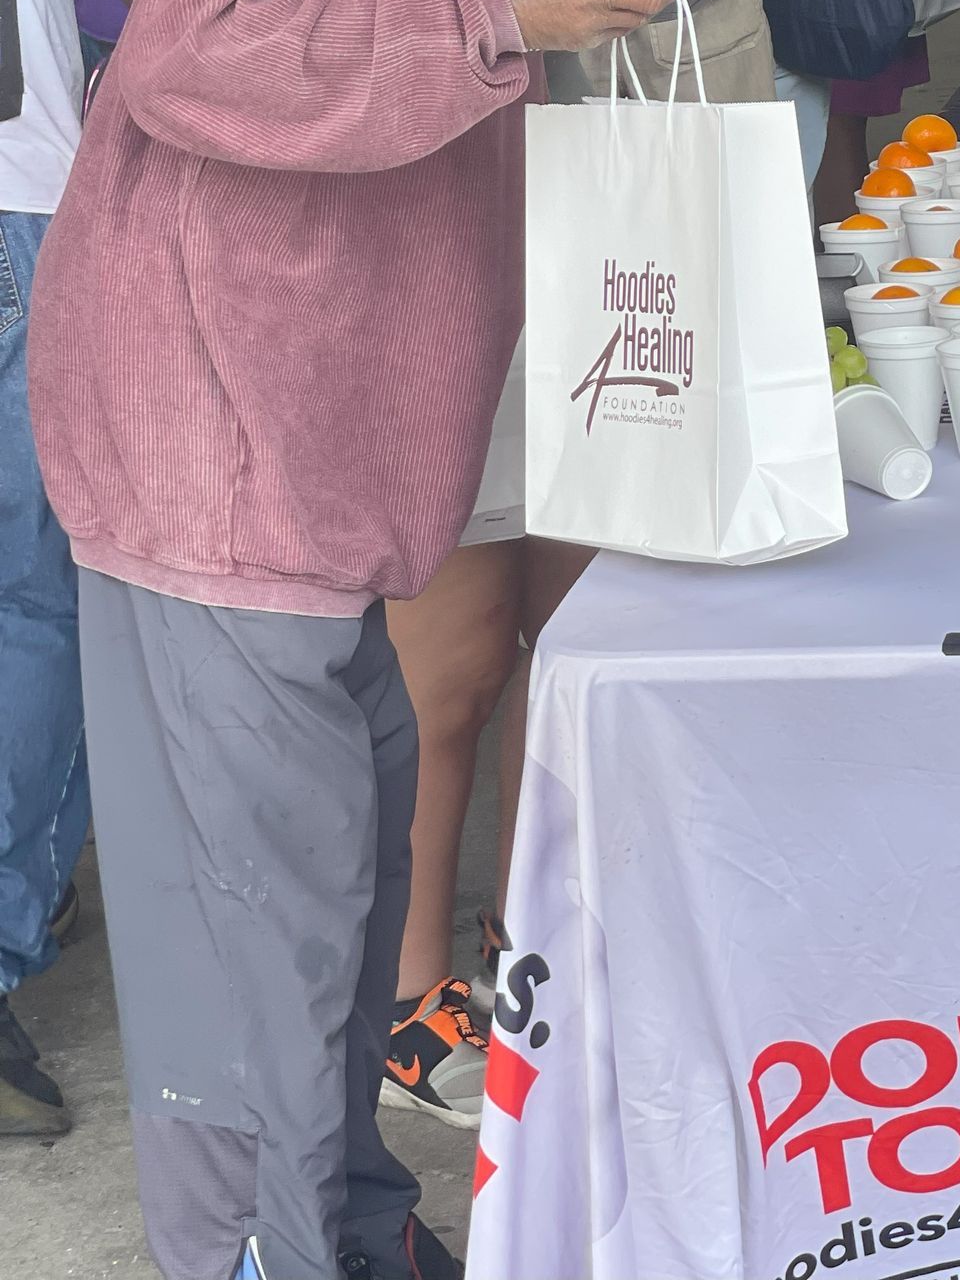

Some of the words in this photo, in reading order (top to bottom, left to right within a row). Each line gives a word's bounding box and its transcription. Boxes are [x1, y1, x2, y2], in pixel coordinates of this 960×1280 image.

[603, 259, 676, 315] Hoodies
[623, 313, 694, 388] Healing
[604, 396, 685, 414] FOUNDATION
[603, 412, 683, 430] www.hoodies4healing.org
[454, 1012, 473, 1035] NIKE
